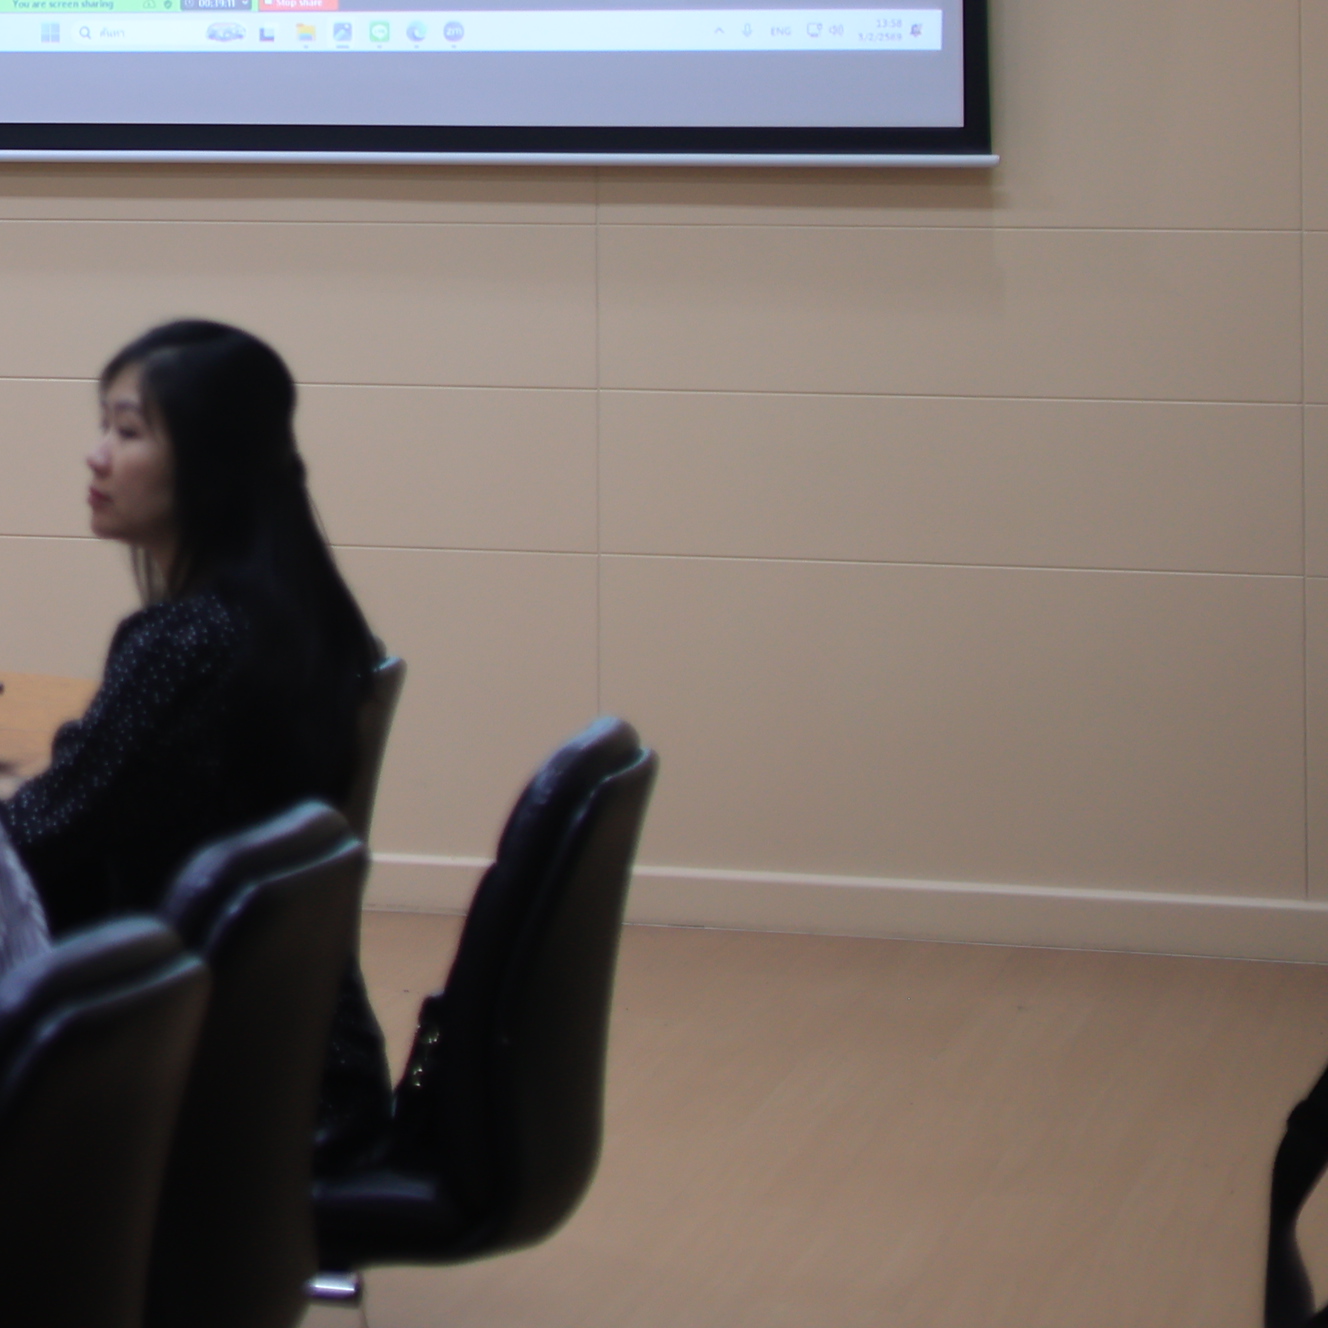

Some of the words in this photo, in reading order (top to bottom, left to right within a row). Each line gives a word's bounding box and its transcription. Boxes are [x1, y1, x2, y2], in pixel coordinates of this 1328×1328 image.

[13, 0, 30, 9] You
[32, 1, 46, 9] are
[49, 0, 79, 9] screen
[770, 26, 792, 37] ENG
